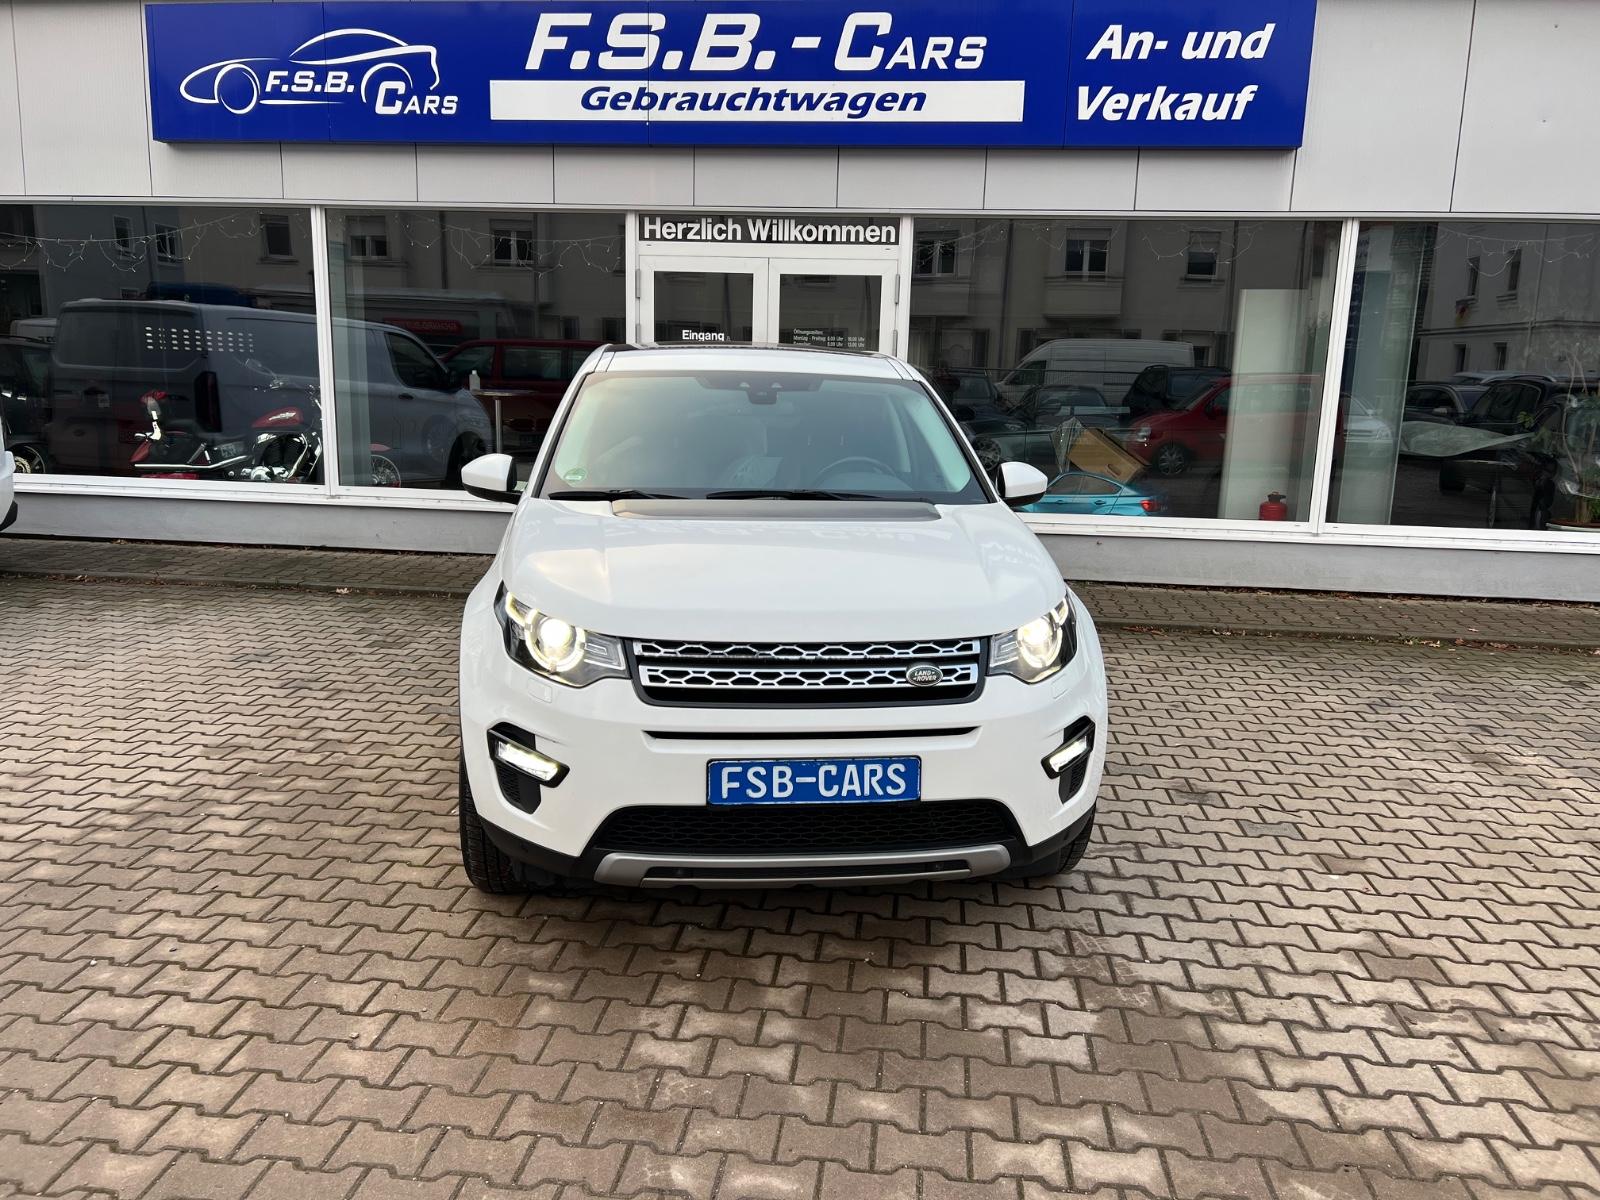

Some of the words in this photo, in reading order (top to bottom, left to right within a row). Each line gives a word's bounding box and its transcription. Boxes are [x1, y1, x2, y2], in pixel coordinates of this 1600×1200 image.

[1086, 24, 1167, 60] An-
[1181, 23, 1275, 60] und
[265, 70, 355, 93] F.S.B.
[581, 86, 927, 119] Gebrauchtwagen
[1076, 85, 1258, 121] Verkauf
[643, 216, 741, 241] Herzlich
[747, 218, 896, 243] Willkommen
[682, 330, 725, 342] Eingang
[721, 763, 907, 799] FSB-CARS
